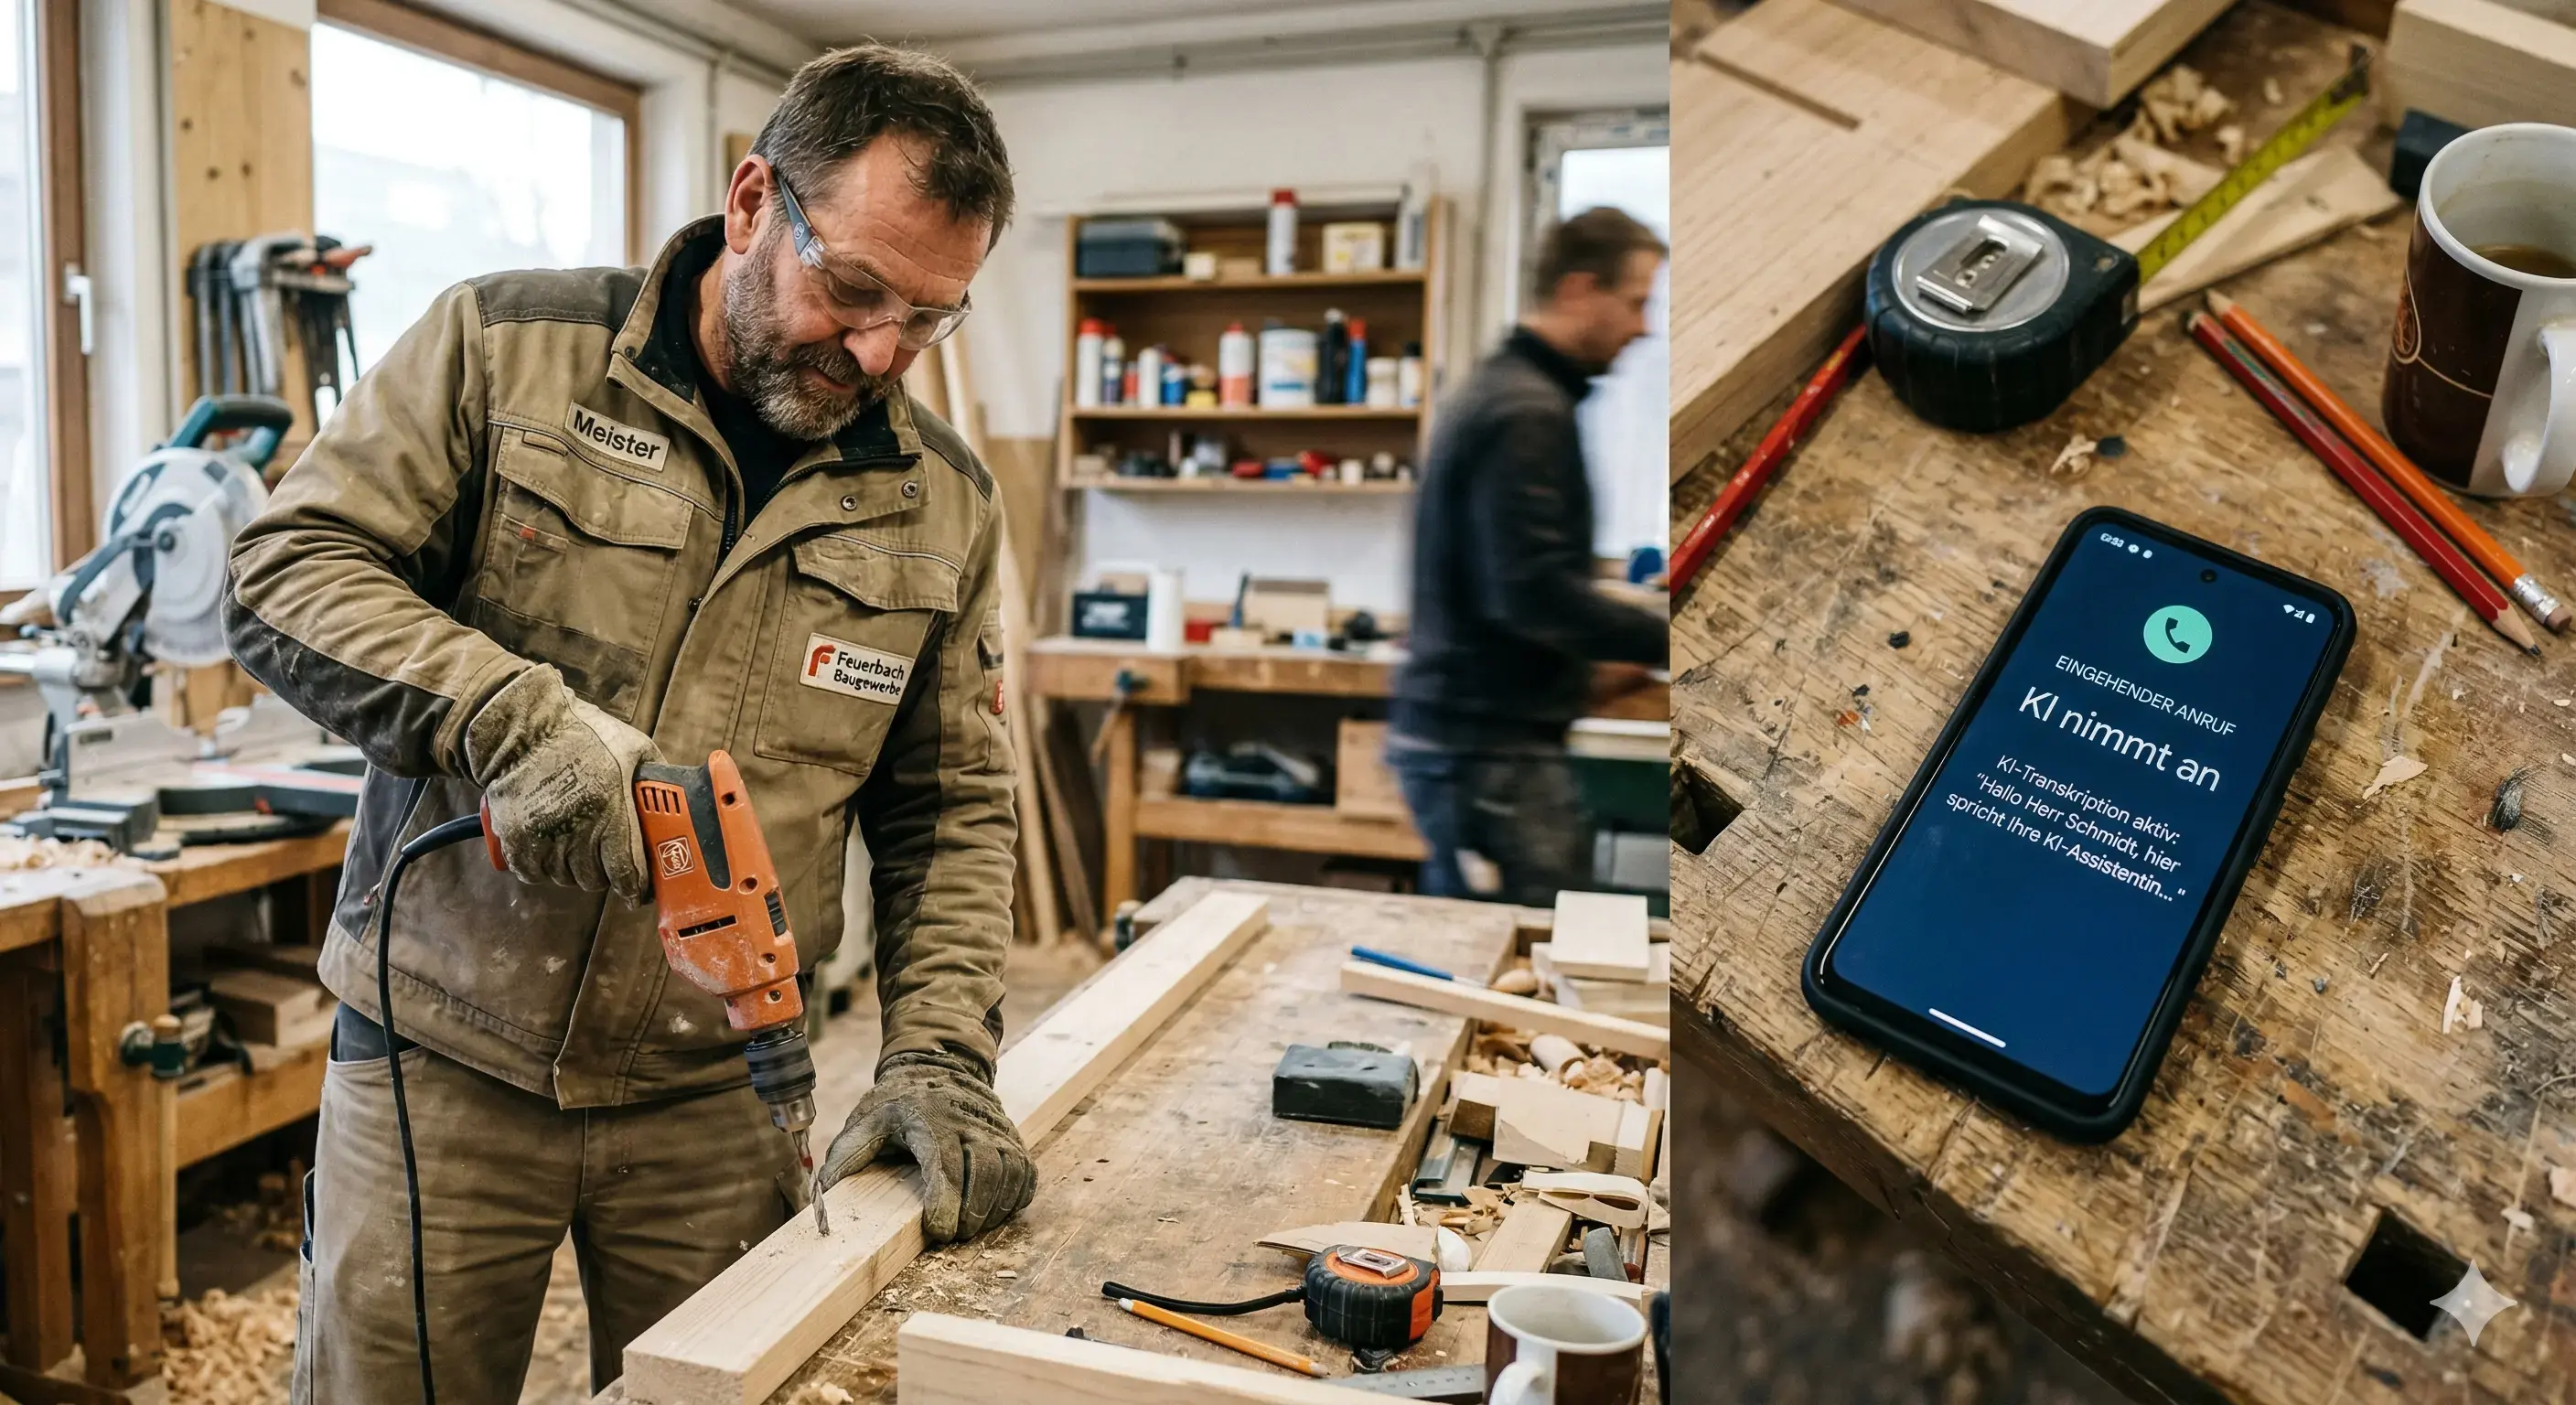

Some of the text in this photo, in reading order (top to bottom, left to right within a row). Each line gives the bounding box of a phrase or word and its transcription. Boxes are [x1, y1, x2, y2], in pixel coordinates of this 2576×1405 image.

[574, 410, 660, 460] Meister
[833, 669, 901, 696] Baugewerbe
[837, 650, 905, 681] Feuerbach
[2055, 655, 2237, 736] EINGEHENDER ANRUF
[2019, 686, 2221, 792] KI nimmt an
[1946, 793, 2006, 828] spricht
[2007, 817, 2041, 842] Ihre
[1977, 772, 2181, 873] “Hallo Herr Schmidt, hier
[1996, 755, 2181, 845] KI-Transkription aktiv:
